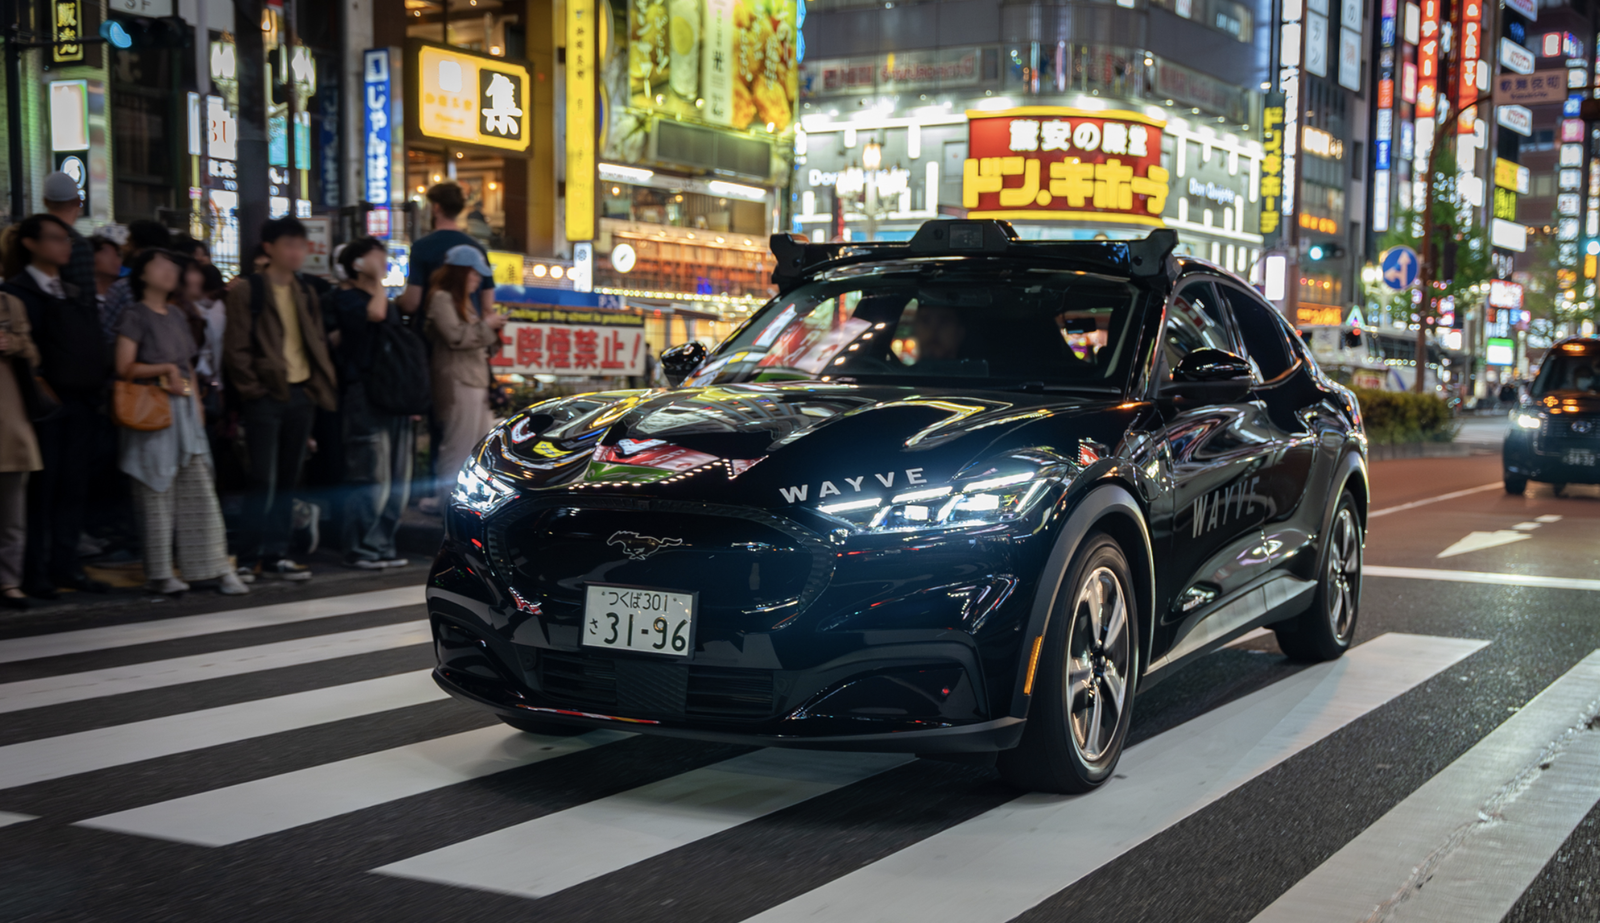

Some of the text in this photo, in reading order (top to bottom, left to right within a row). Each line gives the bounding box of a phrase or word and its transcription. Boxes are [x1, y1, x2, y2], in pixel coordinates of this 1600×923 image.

[779, 468, 927, 503] WAYVE
[1193, 476, 1260, 538] WAYVE
[589, 612, 688, 652] さ 31-96
